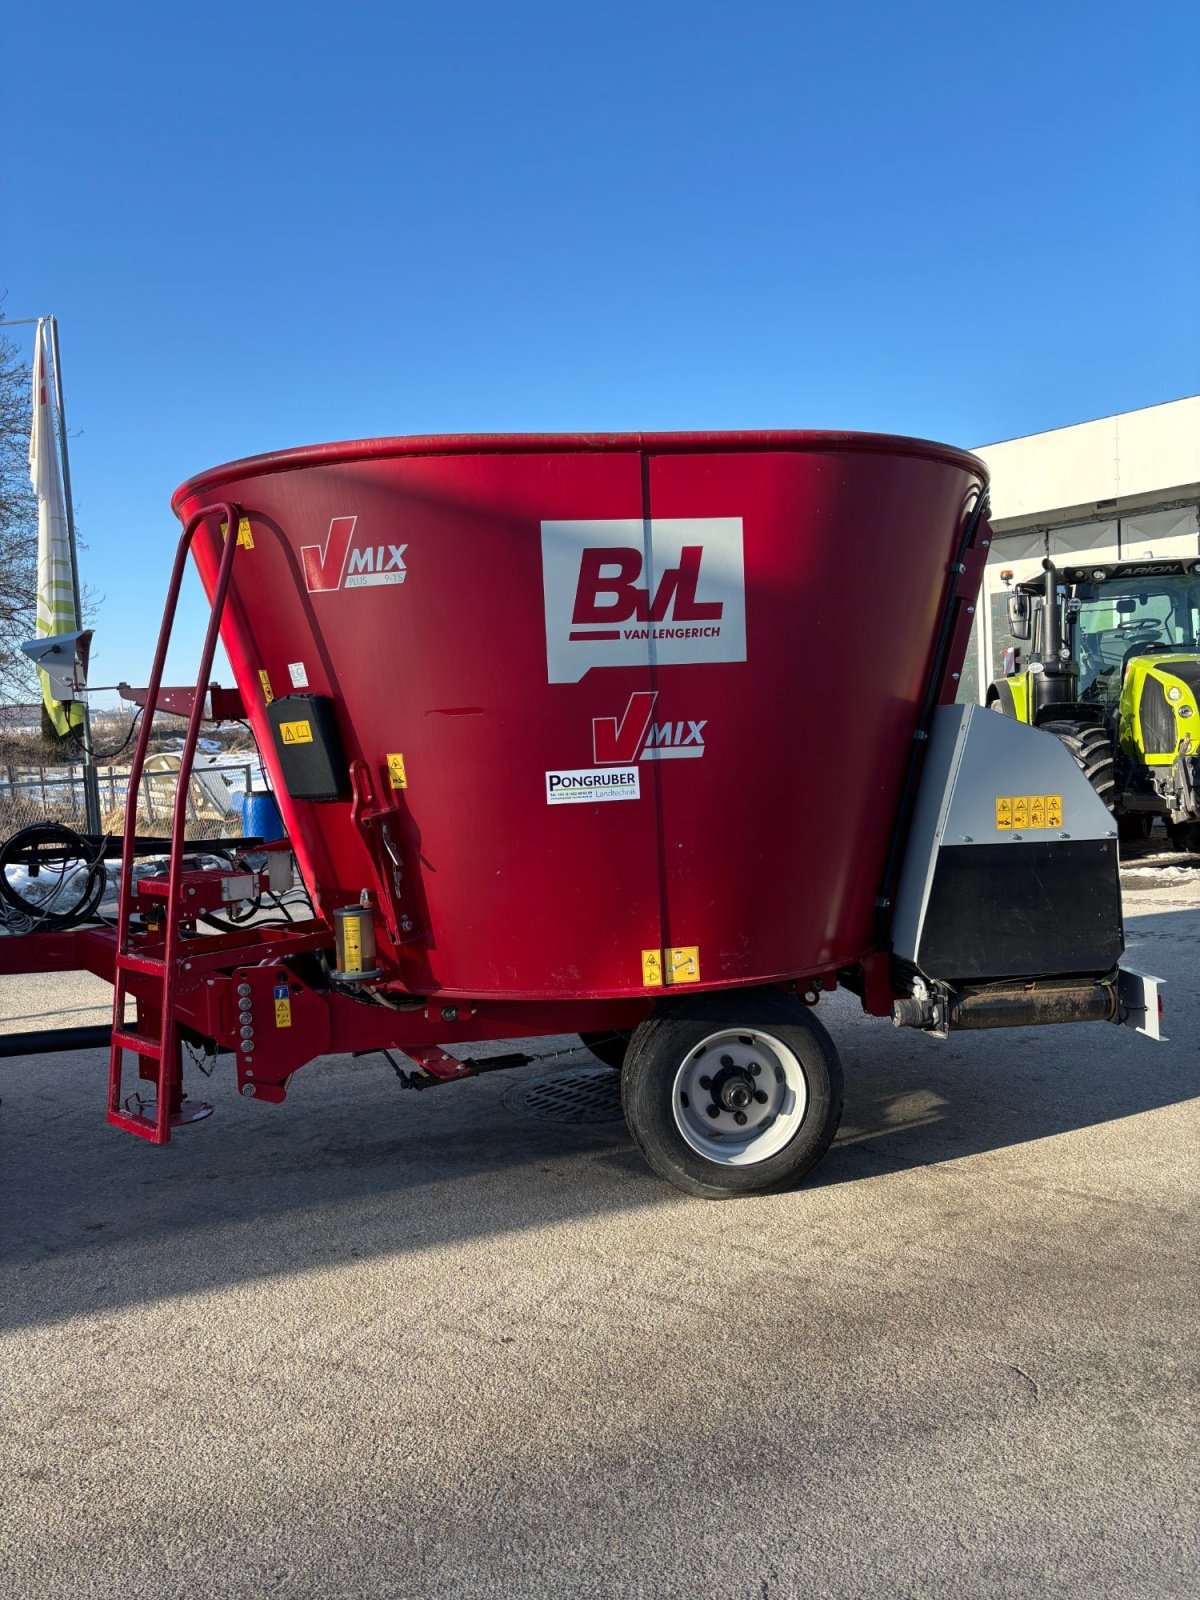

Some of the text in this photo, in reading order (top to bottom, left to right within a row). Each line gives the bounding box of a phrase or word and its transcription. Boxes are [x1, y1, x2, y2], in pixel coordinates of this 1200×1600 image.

[1119, 565, 1179, 575] ARION
[348, 576, 368, 586] PLUS
[624, 627, 721, 640] VAN LENGERICH
[549, 773, 636, 791] PONGRUBER
[595, 788, 637, 798] Landtechnik
